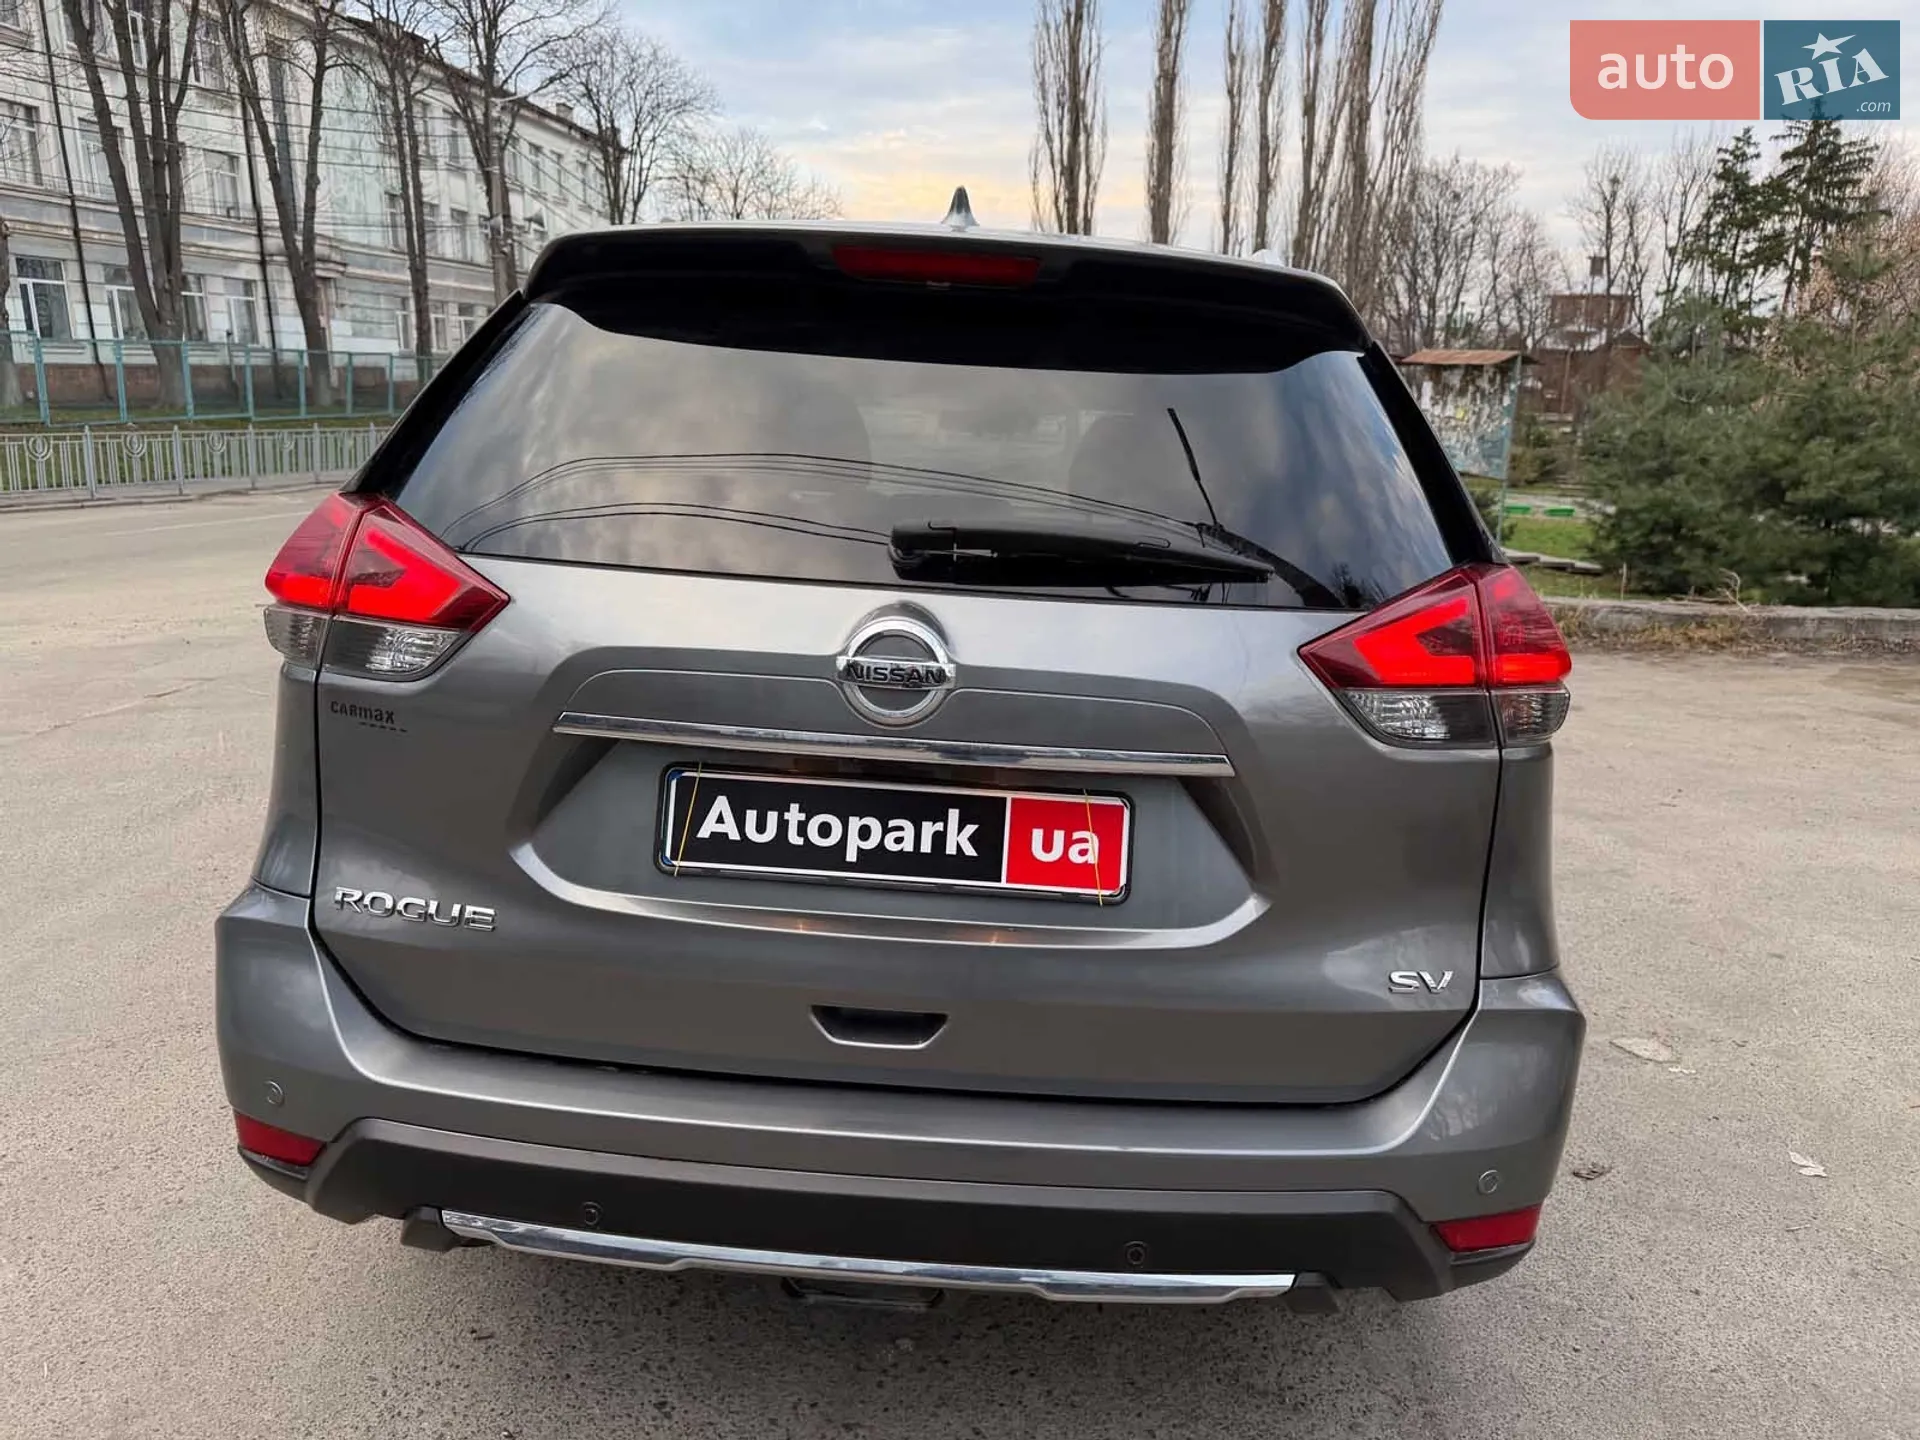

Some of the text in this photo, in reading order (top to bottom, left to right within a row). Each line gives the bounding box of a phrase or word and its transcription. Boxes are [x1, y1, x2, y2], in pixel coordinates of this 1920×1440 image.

[844, 661, 947, 685] NISSAN
[697, 795, 1100, 865] Autopark ua
[334, 886, 497, 932] ROGUE
[1387, 969, 1454, 995] SV
